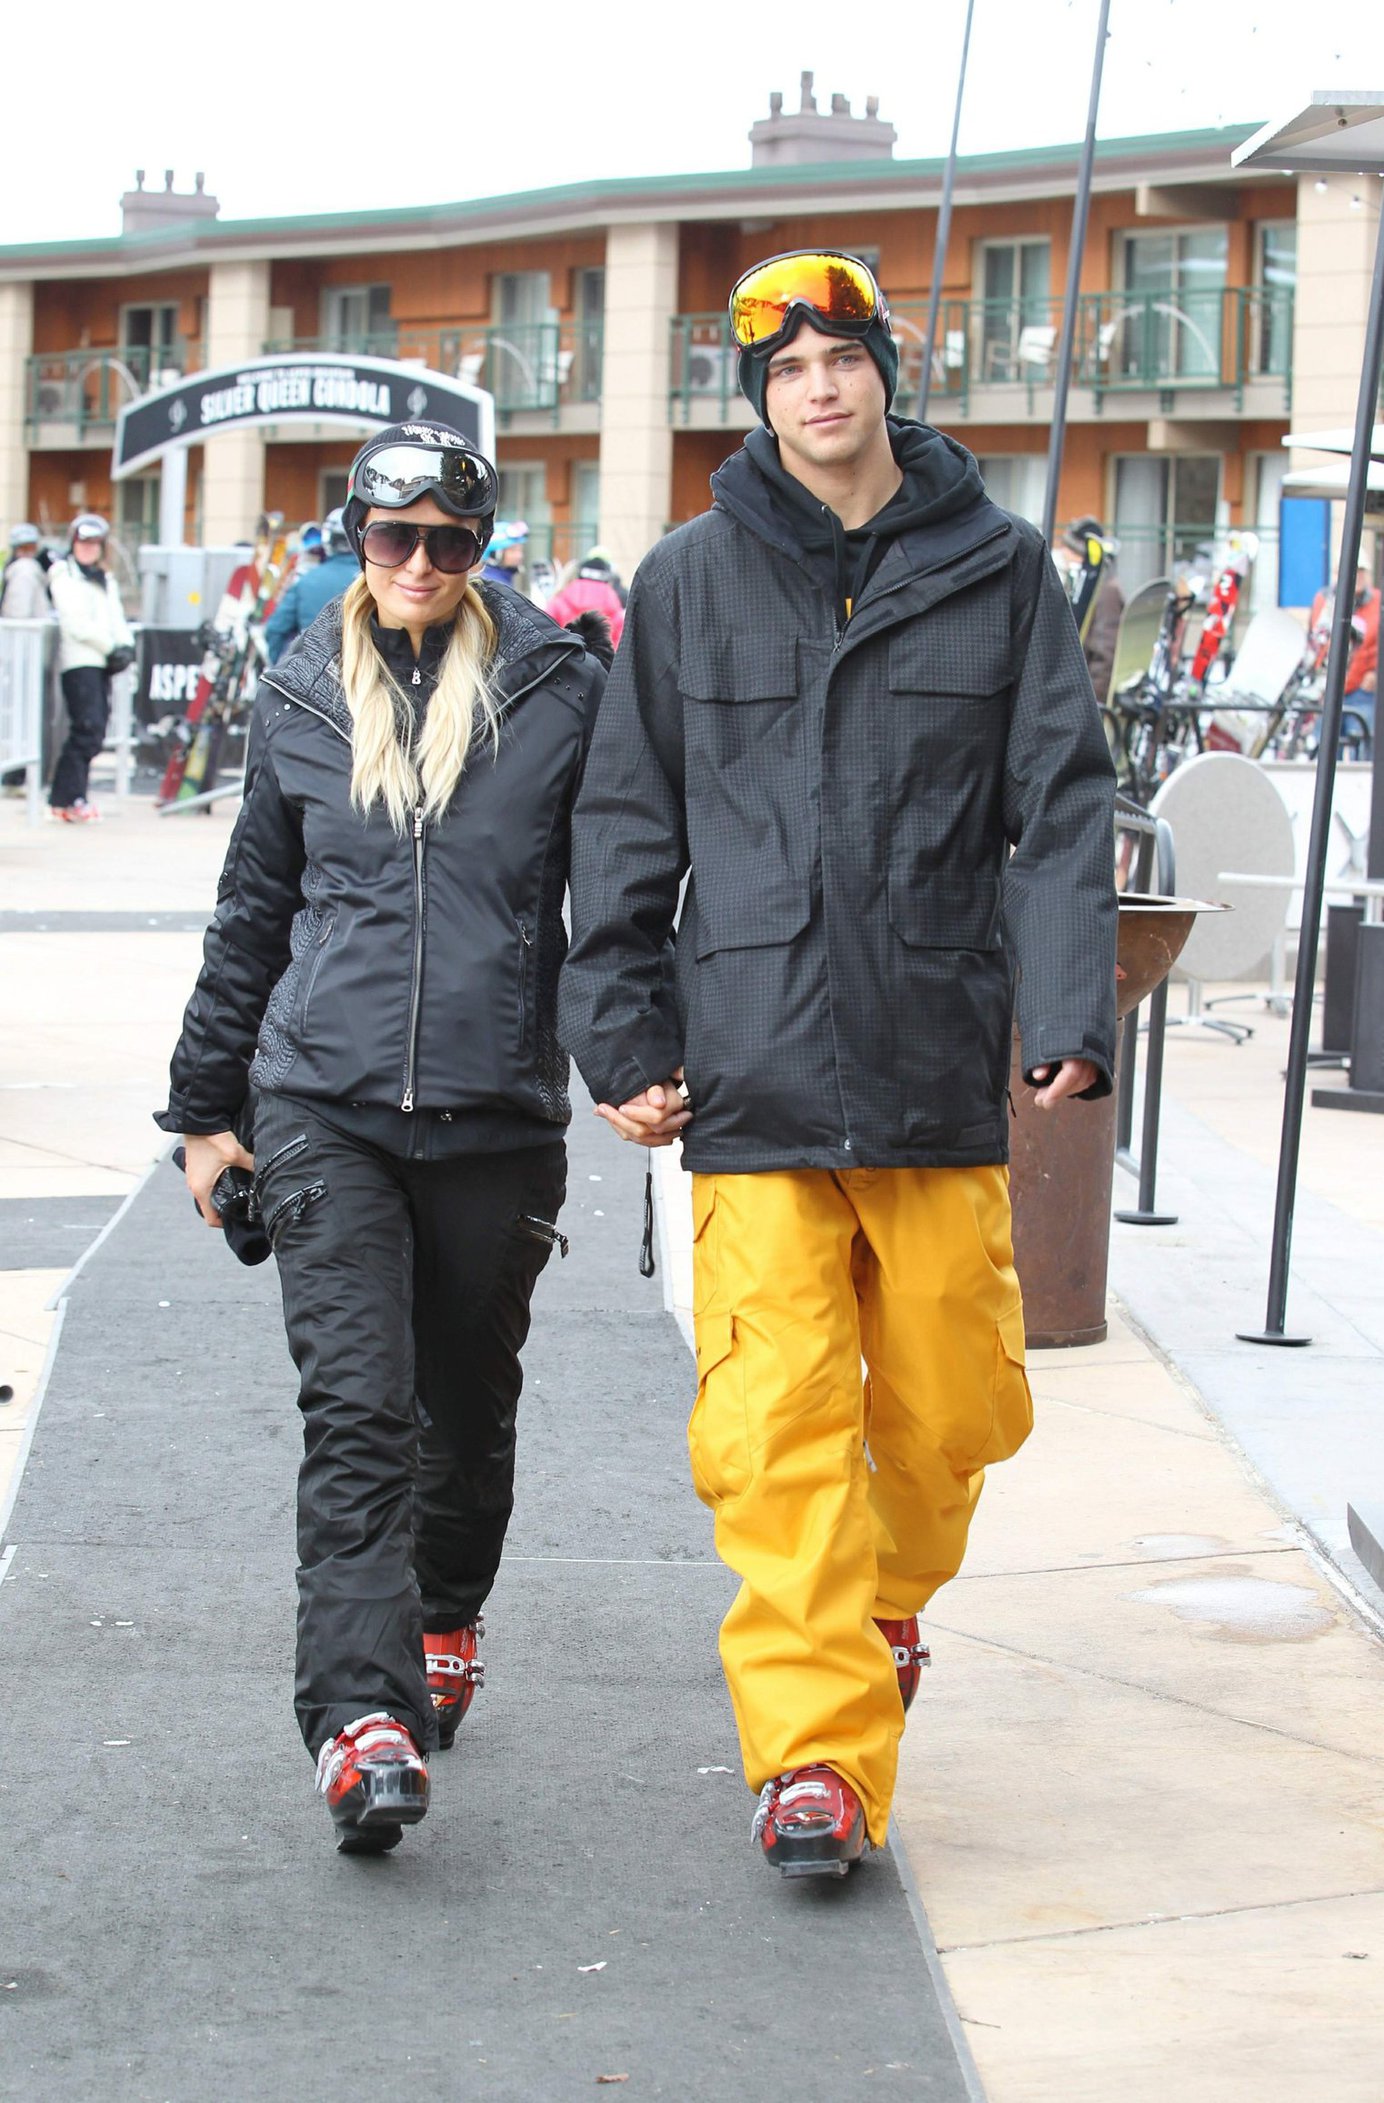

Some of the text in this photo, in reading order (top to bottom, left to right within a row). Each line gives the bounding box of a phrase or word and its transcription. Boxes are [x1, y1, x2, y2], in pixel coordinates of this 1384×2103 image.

[200, 377, 391, 425] SILVER QUEEN GONDOLA
[149, 664, 202, 701] ASPE
